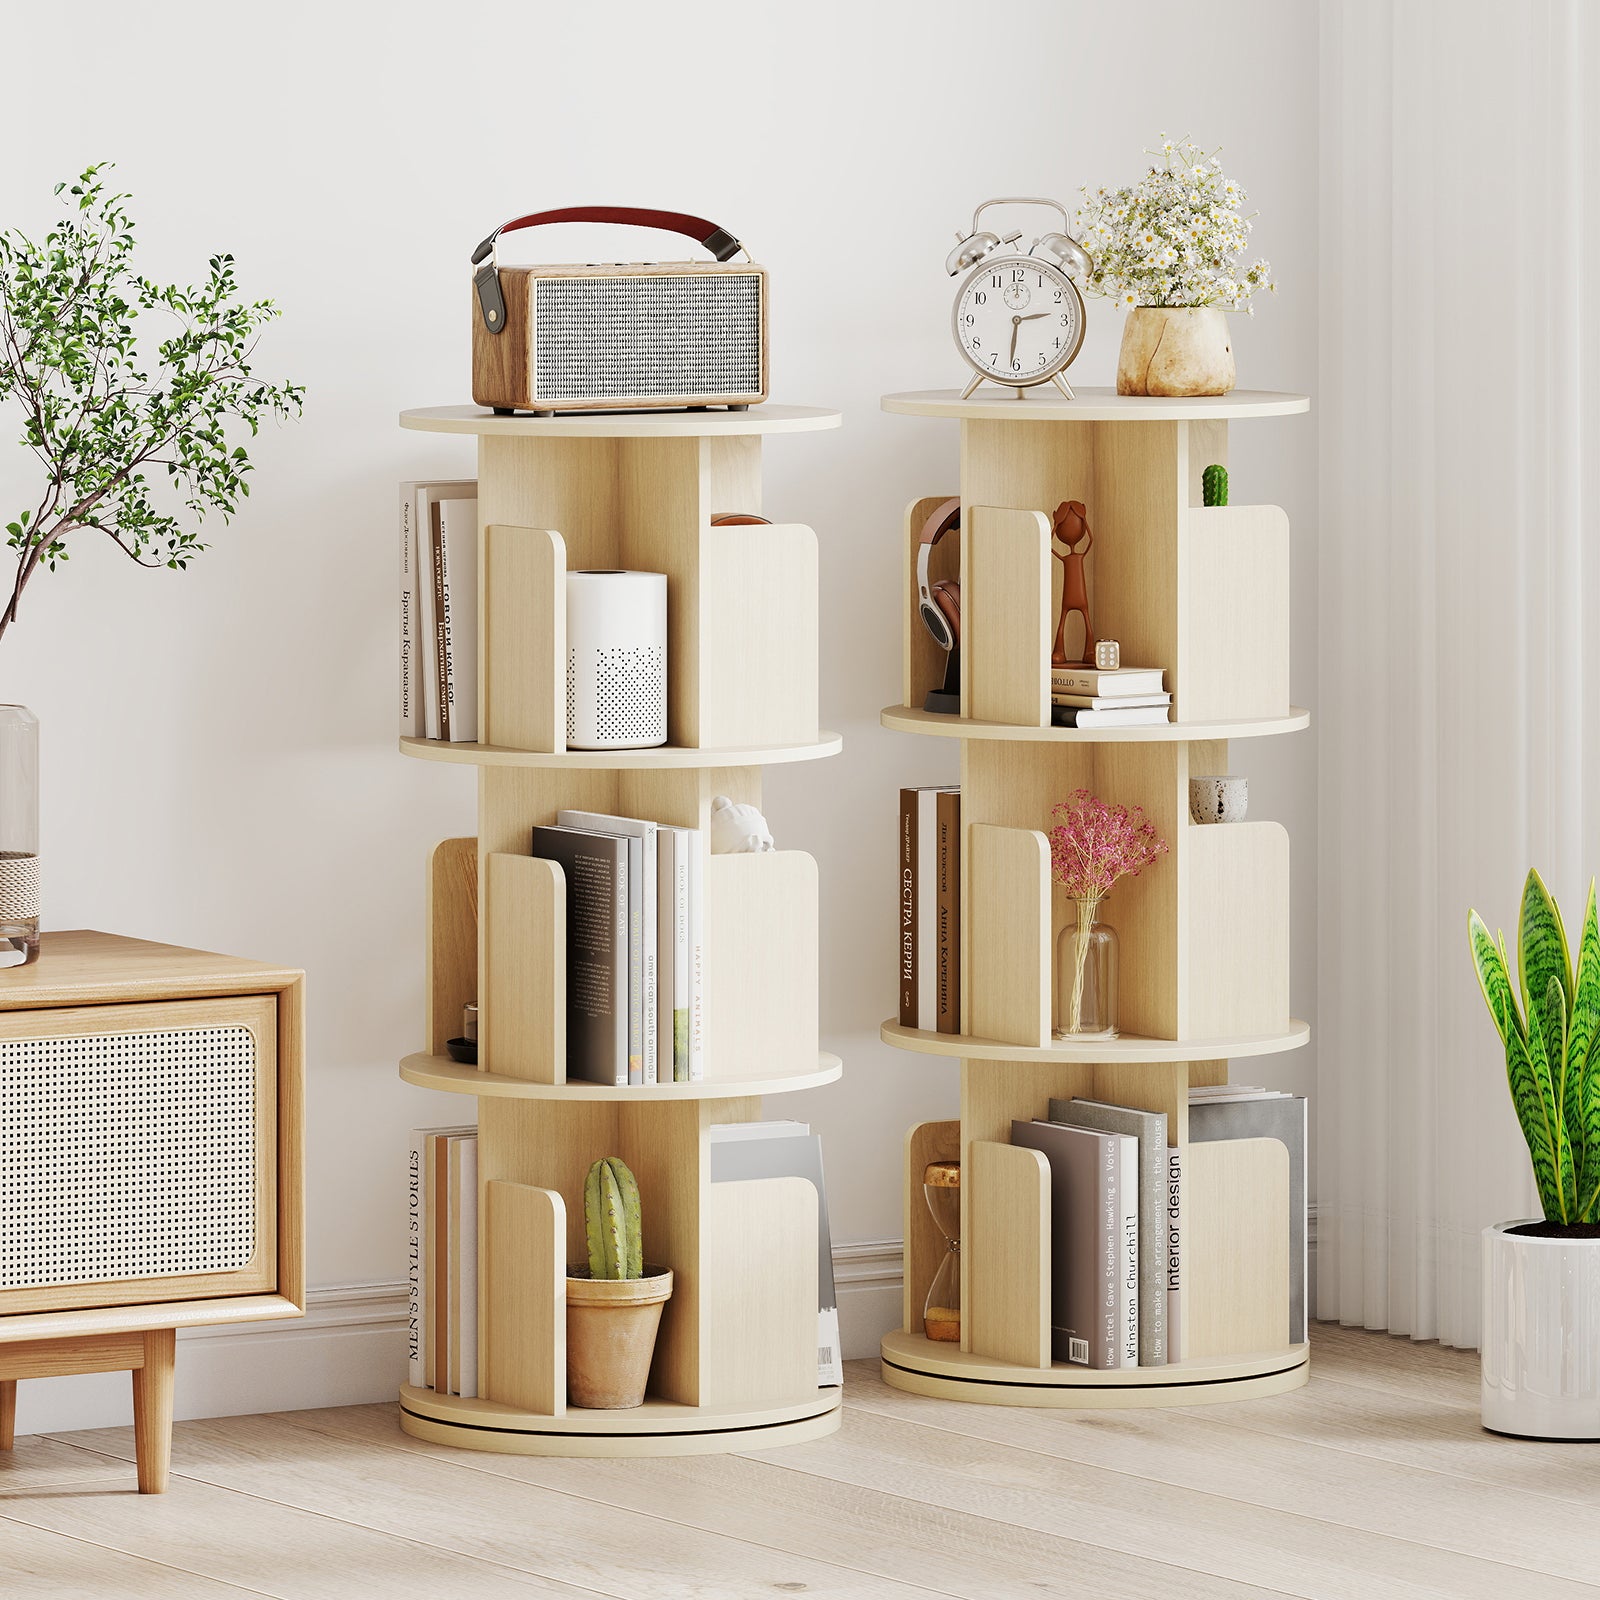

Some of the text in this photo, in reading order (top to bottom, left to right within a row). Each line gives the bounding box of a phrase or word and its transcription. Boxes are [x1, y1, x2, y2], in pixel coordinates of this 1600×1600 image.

[992, 275, 1002, 288] 11
[1012, 270, 1024, 282] 12
[975, 292, 987, 305] 10
[1054, 291, 1062, 304] 2
[966, 314, 974, 327] 9
[1060, 314, 1069, 327] 3
[972, 337, 981, 349] 8
[1052, 337, 1061, 349] 4
[990, 353, 999, 366] 7
[1012, 358, 1021, 371] 6
[1038, 353, 1046, 365] 5
[443, 584, 452, 646] ГОВОРИ
[401, 591, 410, 719] Братья Карамазовы
[437, 622, 448, 724] Бархатная смерть
[618, 894, 625, 908] OF
[679, 897, 685, 911] OF
[903, 868, 912, 980] СЕСТРА КЕРРИ
[632, 949, 639, 962] OF
[632, 965, 640, 1009] EGZOTIC
[632, 1012, 640, 1048] PARROT
[648, 1006, 656, 1036] south
[648, 1038, 656, 1080] animals
[1105, 1140, 1114, 1171] Voice
[1105, 1187, 1116, 1230] Hawking
[1166, 1155, 1181, 1291] Interior design
[1153, 1120, 1164, 1358] How to make an arrangement in the house
[409, 1150, 419, 1362] MEN'S STYLE STORIES
[1105, 1235, 1116, 1277] Stephen
[1106, 1282, 1114, 1307] Gave
[1126, 1214, 1136, 1358] Winston Churchill
[1105, 1312, 1114, 1342] Intel
[1106, 1347, 1115, 1366] How
